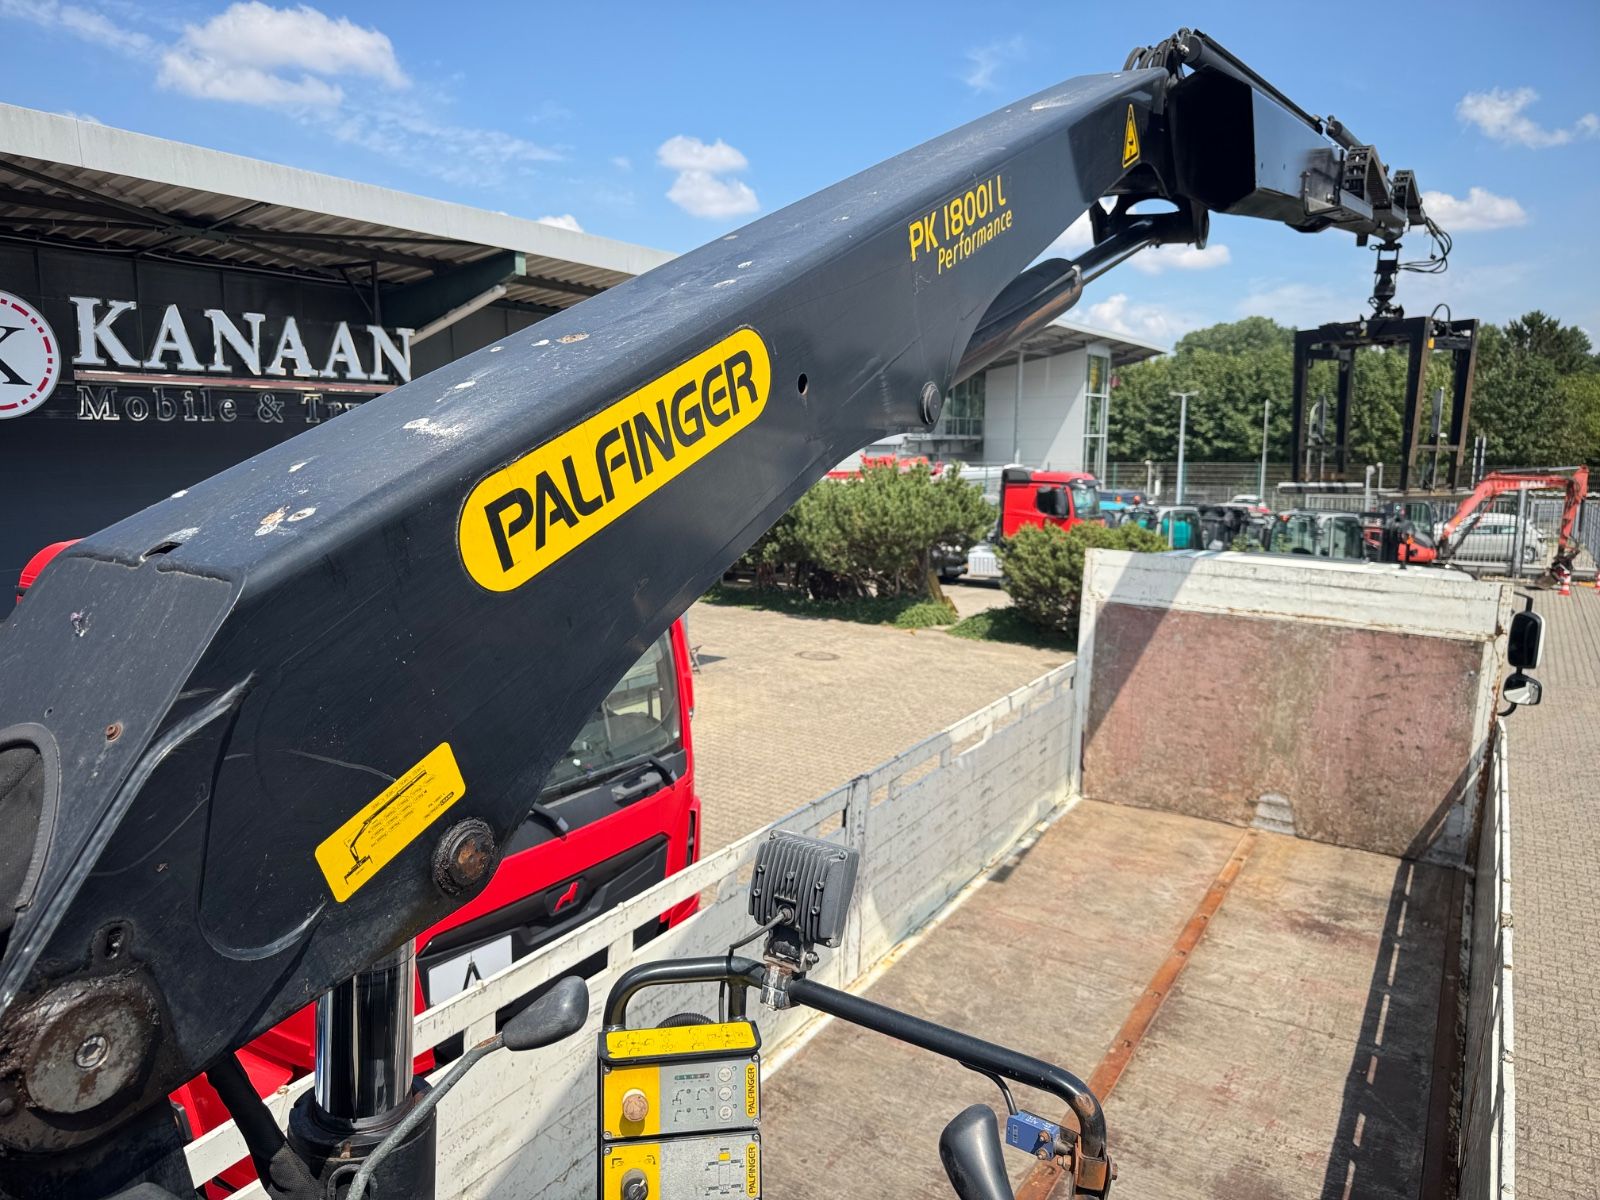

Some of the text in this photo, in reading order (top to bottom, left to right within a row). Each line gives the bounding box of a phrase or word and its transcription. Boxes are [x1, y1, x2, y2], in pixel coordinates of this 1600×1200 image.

[909, 175, 1006, 262] PK 18001 L
[938, 210, 1012, 275] Performance
[69, 296, 415, 383] KANAAN
[77, 385, 237, 422] Mobile
[257, 391, 284, 423] &
[484, 350, 758, 573] PALFINGER
[747, 1067, 755, 1114] PALFINGER
[748, 1146, 756, 1194] PALFINGER
